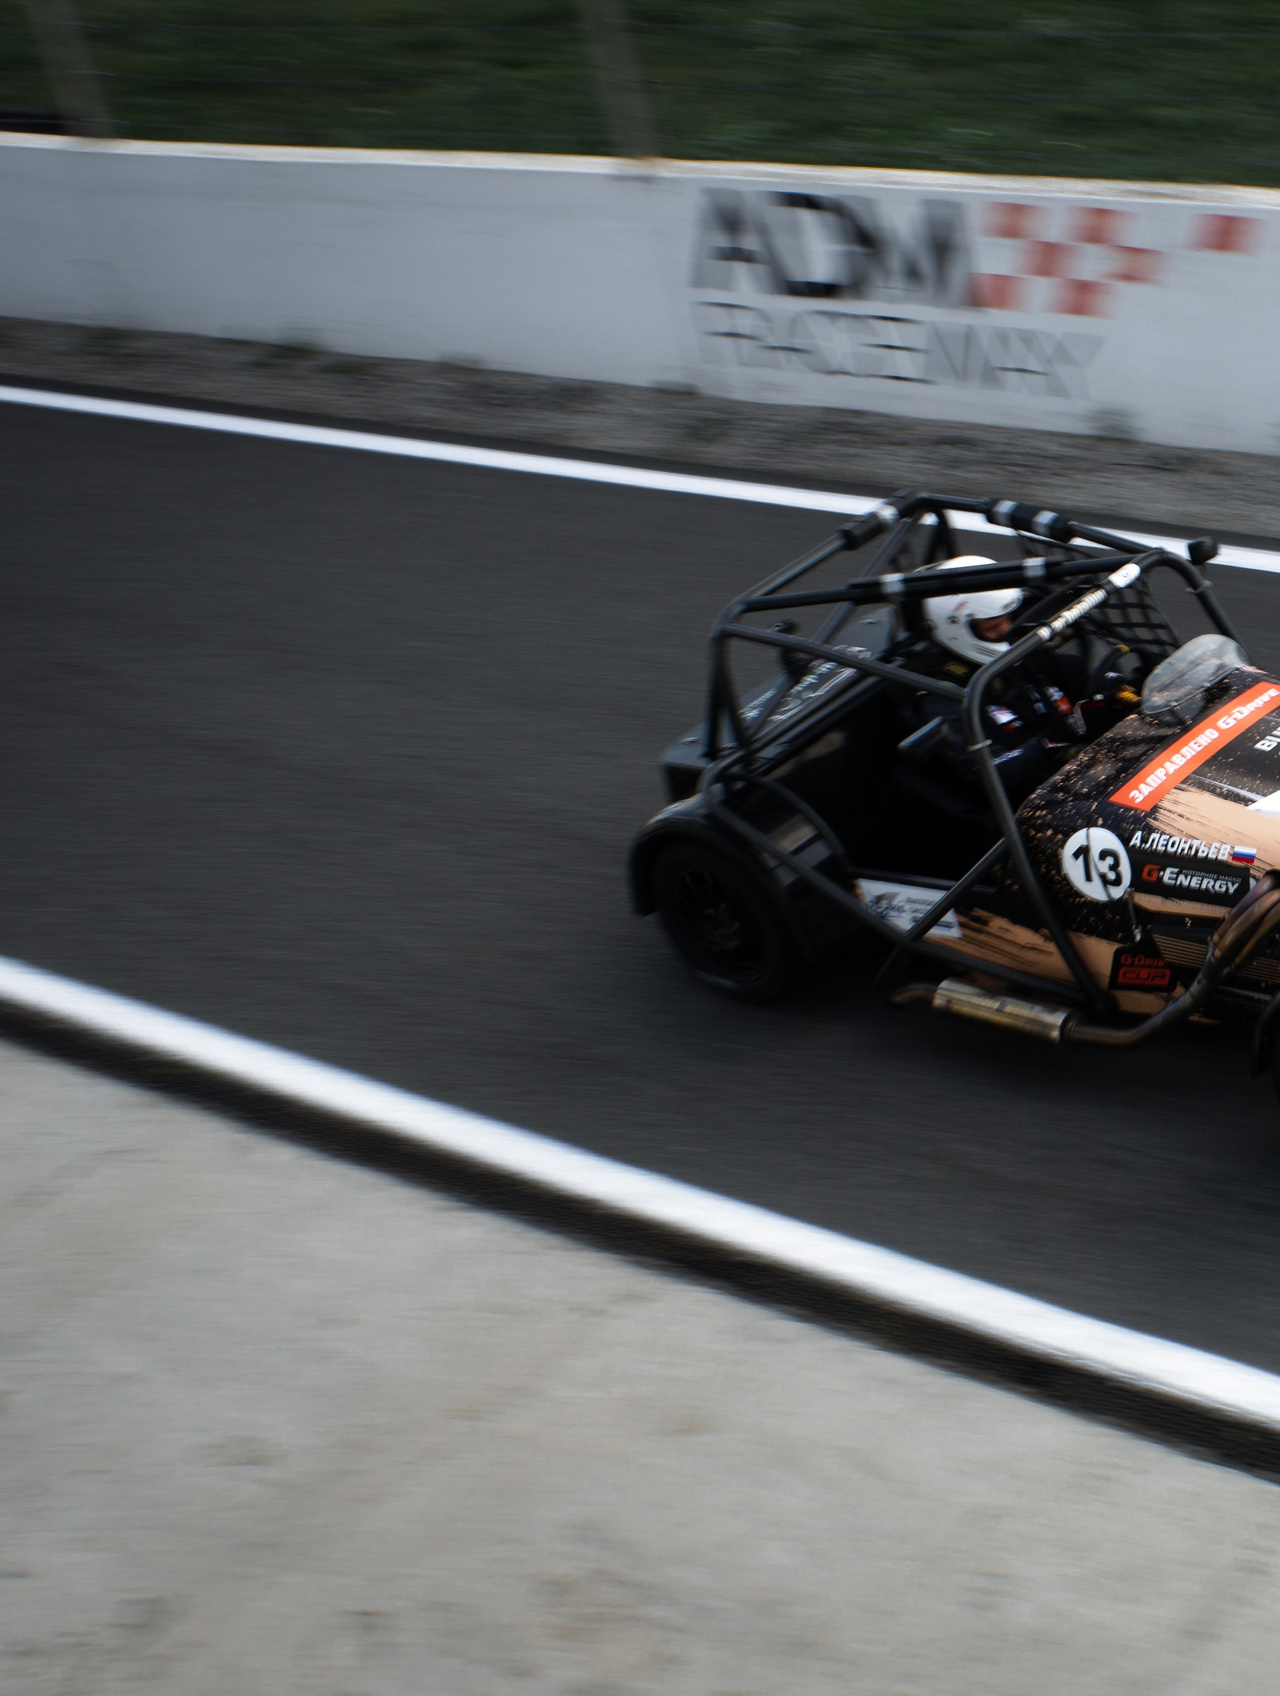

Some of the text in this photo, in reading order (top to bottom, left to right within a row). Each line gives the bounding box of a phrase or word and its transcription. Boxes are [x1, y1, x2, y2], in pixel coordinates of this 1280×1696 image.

[692, 187, 982, 309] ADM
[695, 301, 1104, 399] RACEWAY
[1129, 728, 1220, 804] ЗАПРАВЛЕНО
[1071, 843, 1123, 887] 13
[1122, 970, 1166, 982] CUP
